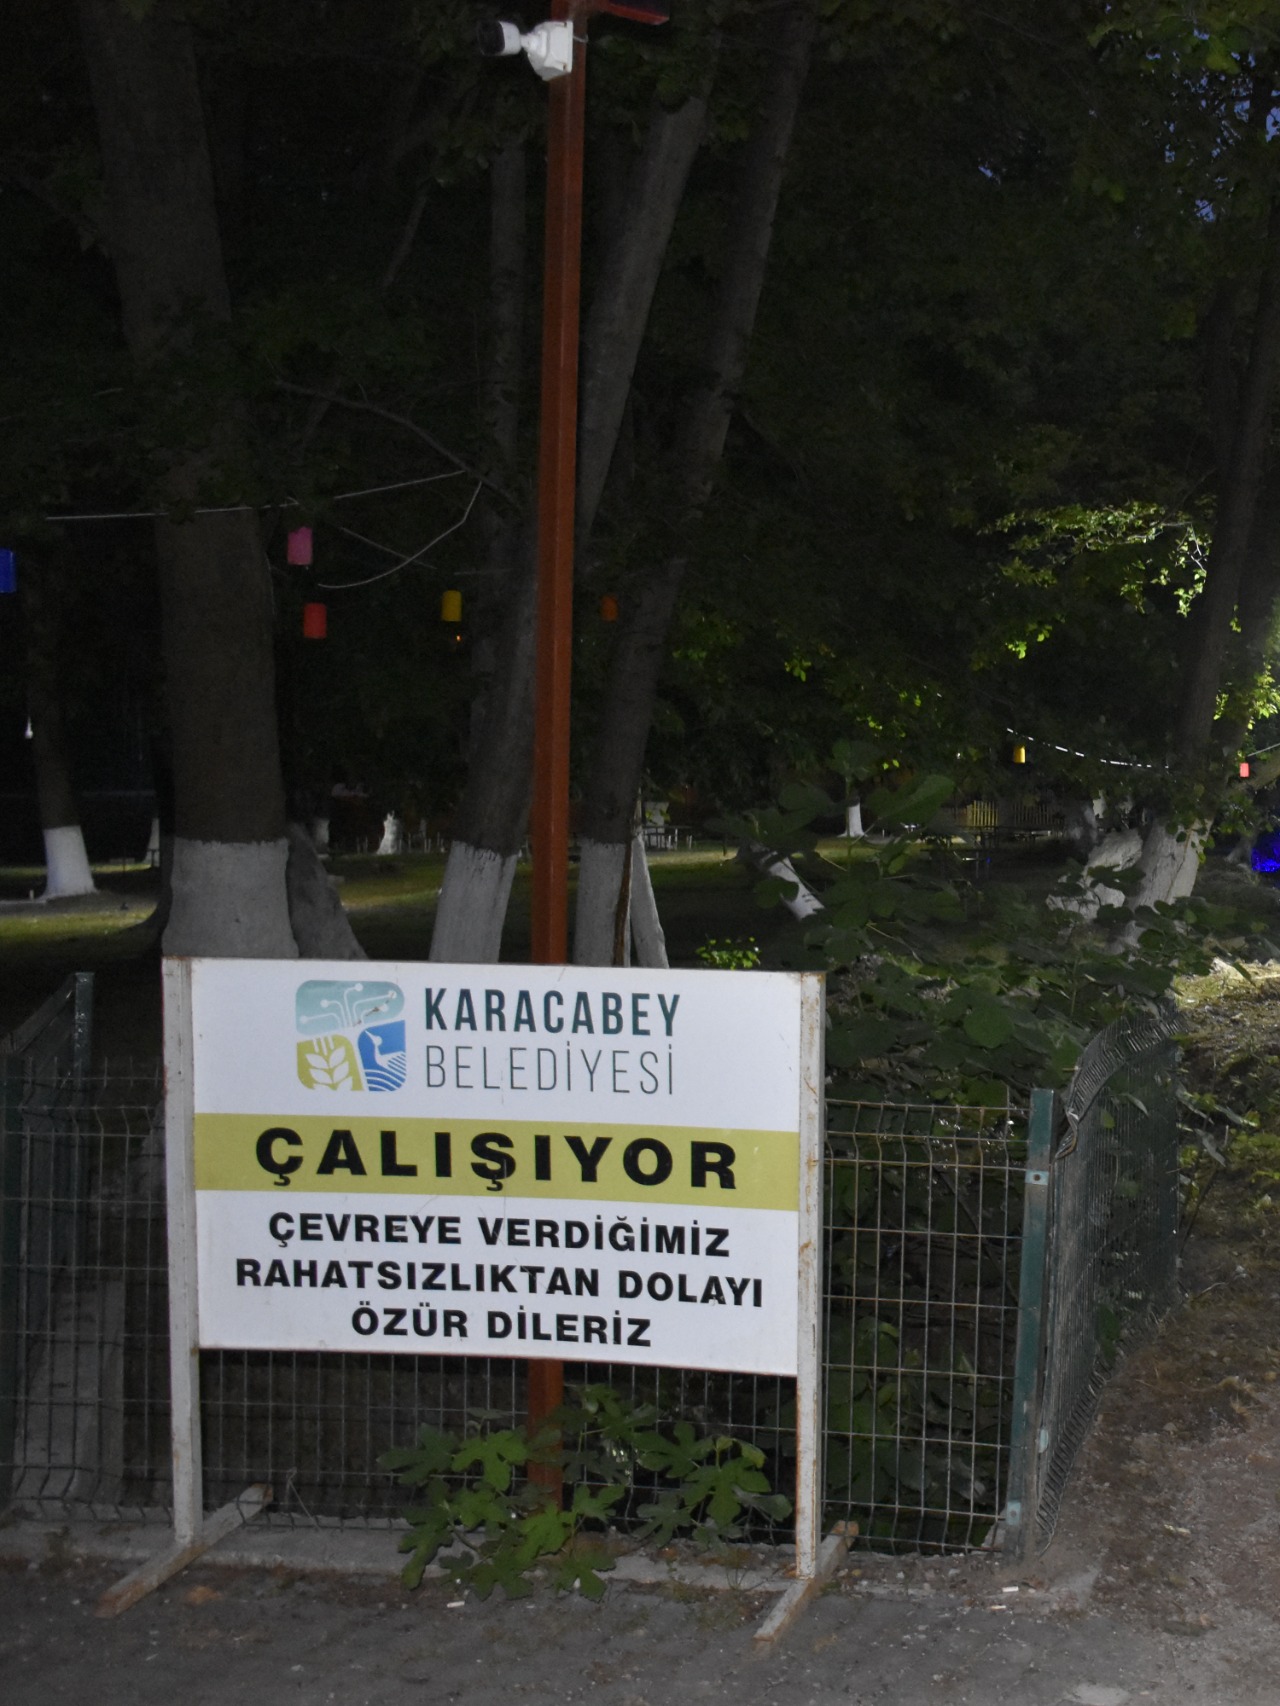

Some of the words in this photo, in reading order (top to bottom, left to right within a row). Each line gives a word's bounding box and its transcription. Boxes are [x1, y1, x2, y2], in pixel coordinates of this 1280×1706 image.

[425, 988, 679, 1036] KARACABEY
[427, 1041, 672, 1094] BELEDİYESİ
[256, 1127, 736, 1192] ÇALIŞIYOR
[269, 1212, 461, 1248] ÇEVREYE
[478, 1215, 729, 1257] VERDİĞİMİZ
[236, 1258, 598, 1297] RAHATSIZLIKTAN
[619, 1270, 762, 1307] DOLAYI
[352, 1301, 468, 1337] ÖZÜR
[488, 1305, 651, 1347] DİLERİZ
